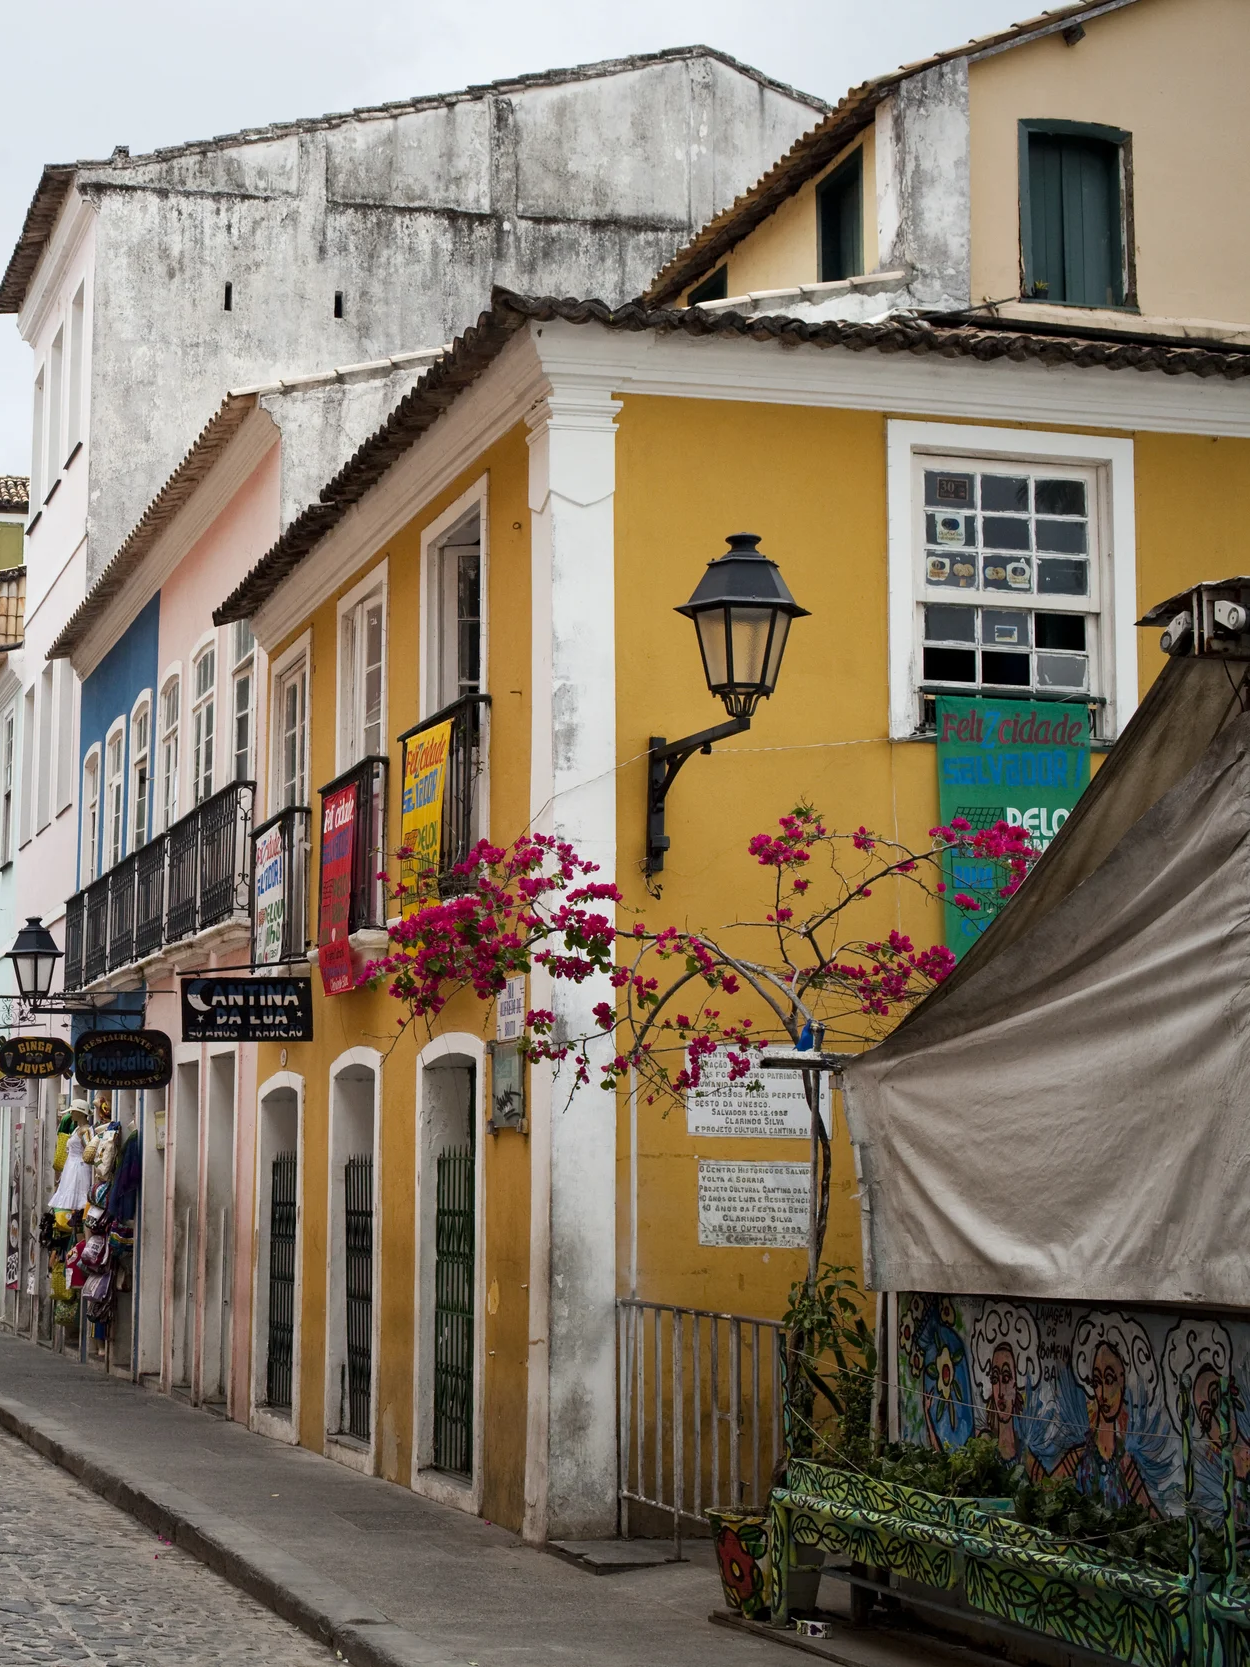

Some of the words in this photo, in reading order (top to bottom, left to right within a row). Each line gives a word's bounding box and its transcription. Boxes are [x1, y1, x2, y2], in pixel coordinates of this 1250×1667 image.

[940, 480, 955, 493] 30
[187, 980, 299, 1011] CANTINA
[216, 1008, 242, 1024] DA
[249, 1008, 288, 1024] LUA
[83, 1033, 153, 1051] RESTAURANTE
[84, 1051, 156, 1076] Tropicália
[86, 1073, 162, 1087] LANCHONETE
[712, 1109, 747, 1117] SALVADOR
[725, 1117, 761, 1125] CLARINDO
[764, 1117, 785, 1126] SILVA
[701, 1126, 732, 1134] PROJETO
[734, 1126, 767, 1134] CULTURAL
[769, 1127, 797, 1135] CANTINA
[702, 1175, 725, 1183] VOLTA
[699, 1185, 728, 1193] PROJETO
[729, 1185, 760, 1193] CULTURAL
[762, 1186, 791, 1194] CANTINA
[752, 1205, 776, 1213] FESTA
[788, 1206, 808, 1215] BENÇ
[722, 1214, 766, 1222] CLARINDO
[770, 1215, 793, 1223] SILVA
[741, 1225, 777, 1233] OUTUBRO
[1036, 1304, 1072, 1327] LAVAGEM
[1047, 1327, 1057, 1338] DO
